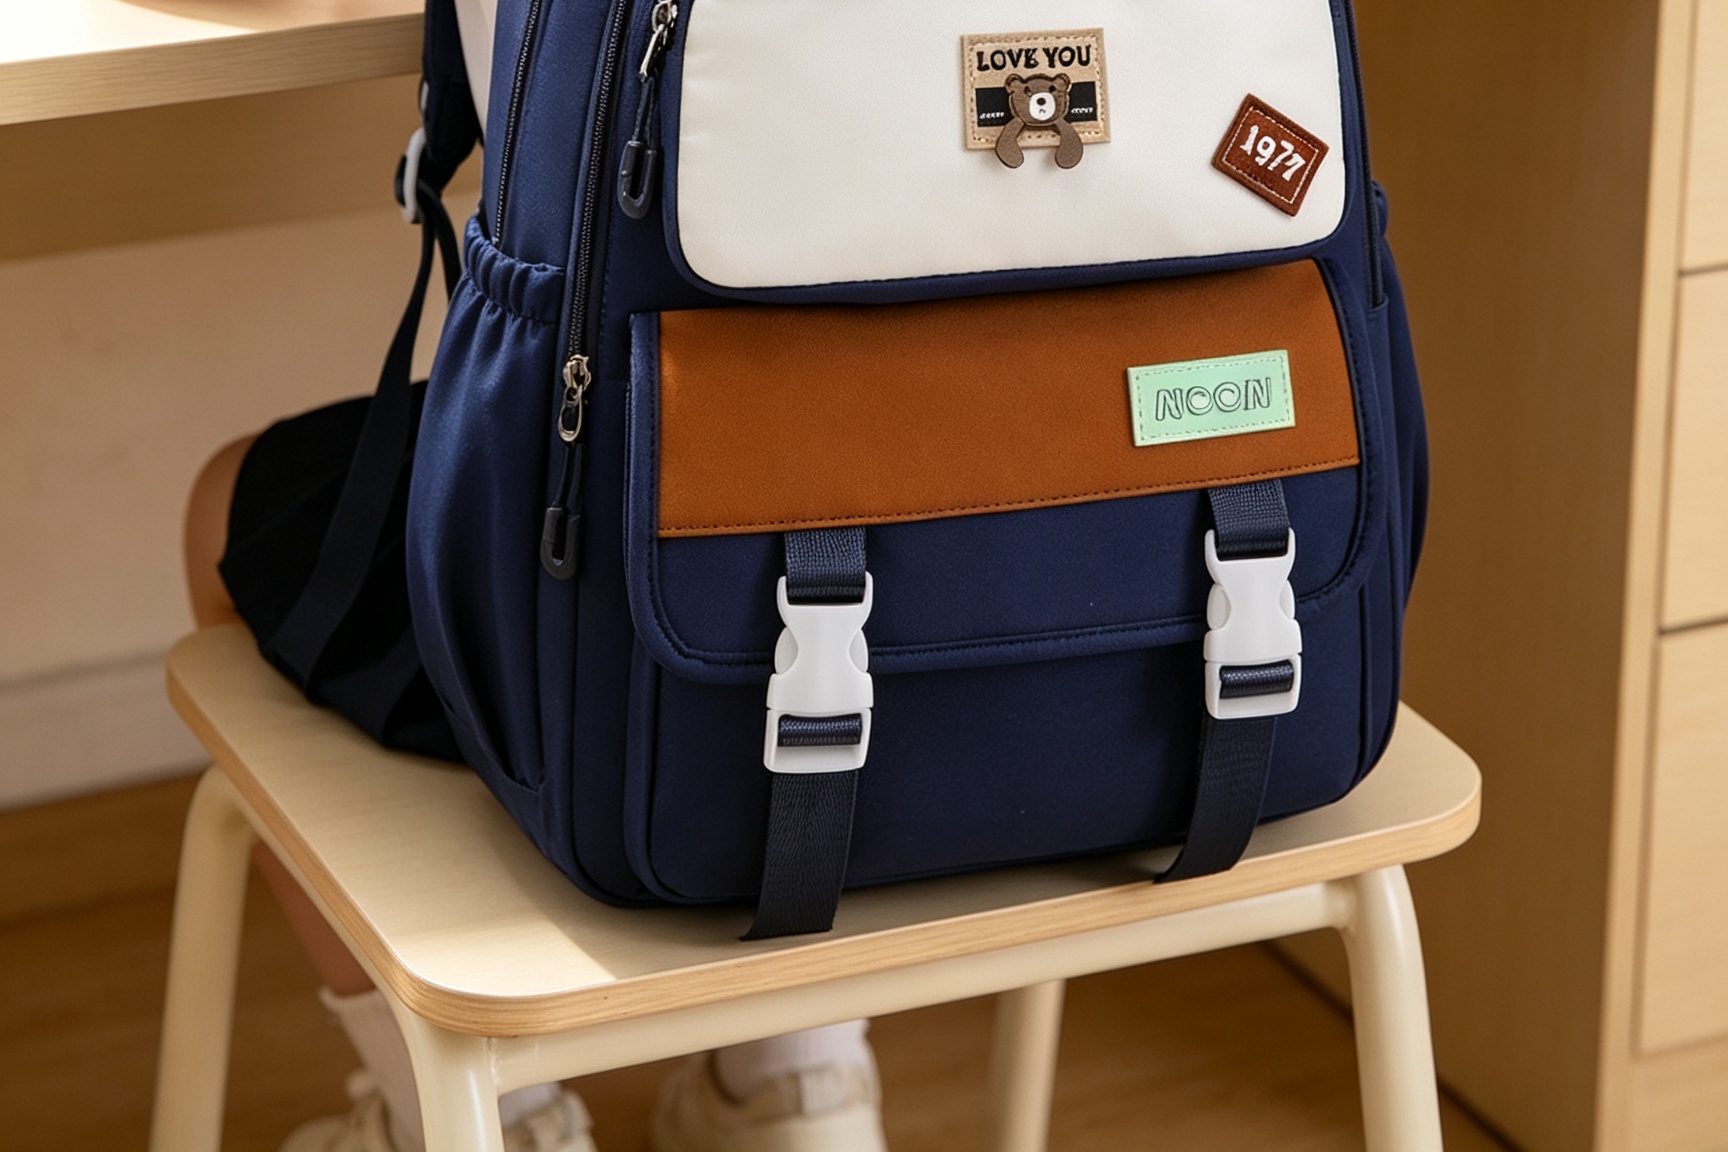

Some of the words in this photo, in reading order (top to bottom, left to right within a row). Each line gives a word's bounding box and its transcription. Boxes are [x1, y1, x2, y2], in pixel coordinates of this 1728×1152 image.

[976, 47, 1039, 71] LOVE
[1042, 44, 1092, 68] YOU
[1240, 125, 1306, 181] 1977
[1155, 377, 1272, 421] NOON
